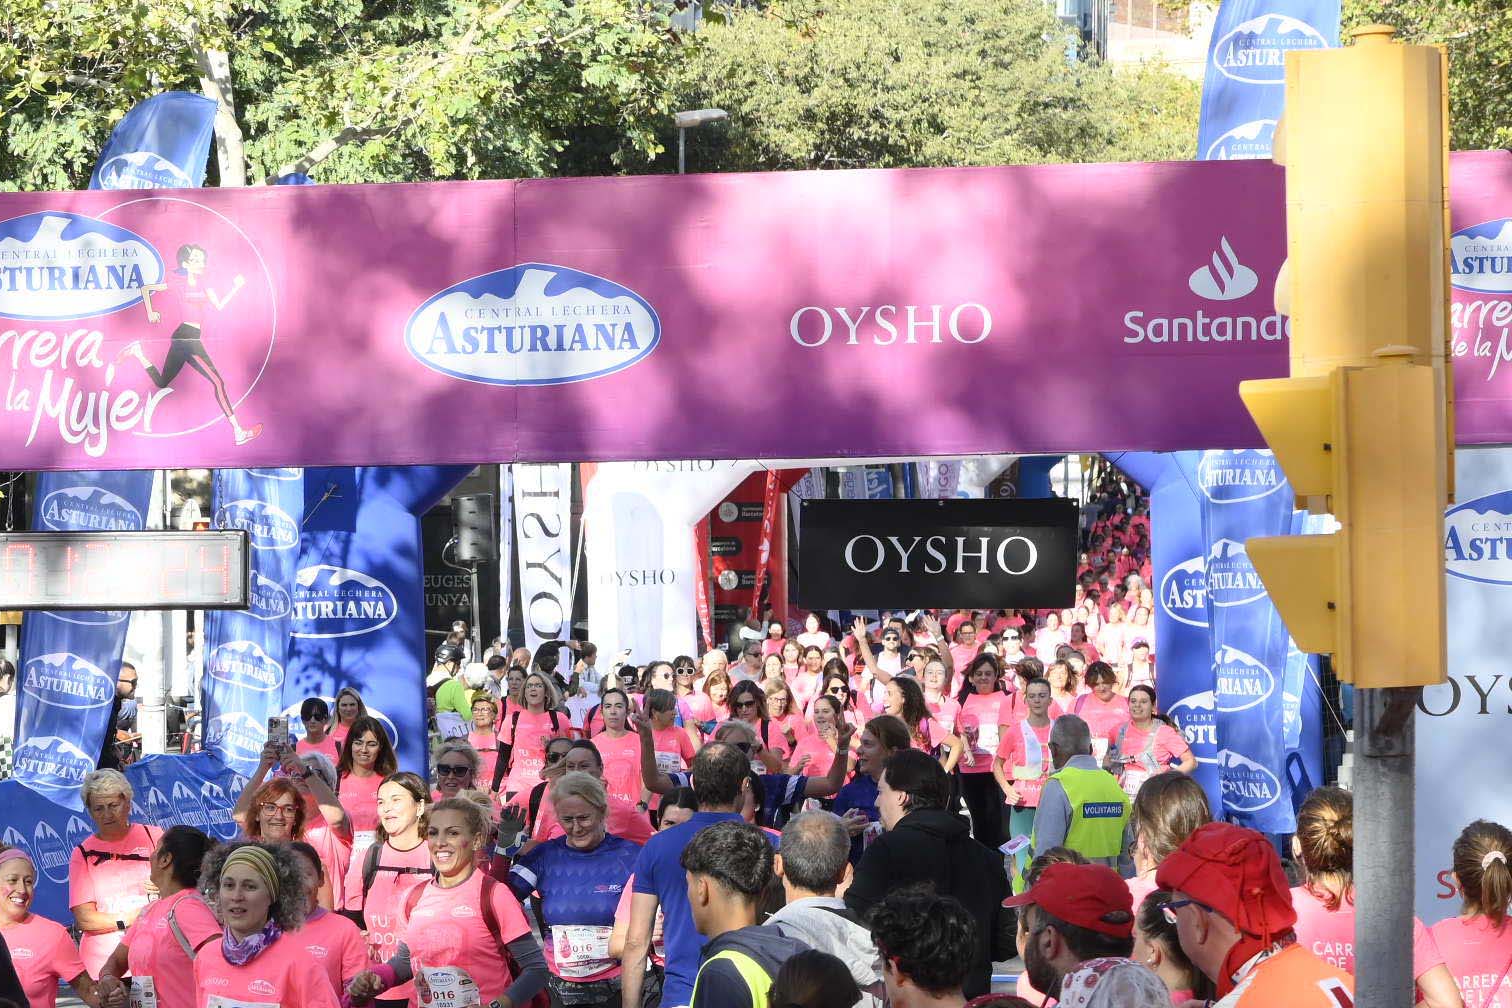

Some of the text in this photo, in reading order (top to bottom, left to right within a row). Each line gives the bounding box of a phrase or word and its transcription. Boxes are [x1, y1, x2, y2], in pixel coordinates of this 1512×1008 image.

[64, 247, 139, 259] LECHERA
[463, 304, 632, 320] CENTRAL LECHERA
[790, 302, 992, 347] OYSHO
[425, 311, 641, 355] ASTURIANA
[5, 371, 31, 413] la
[25, 362, 175, 458] Mujer
[45, 499, 136, 531] ASTURIANA
[845, 534, 1038, 576] OYSHO
[334, 589, 384, 599] LECHERA
[24, 667, 106, 701] ASTURIANA
[572, 943, 593, 953] 016
[433, 990, 455, 1000] 016
